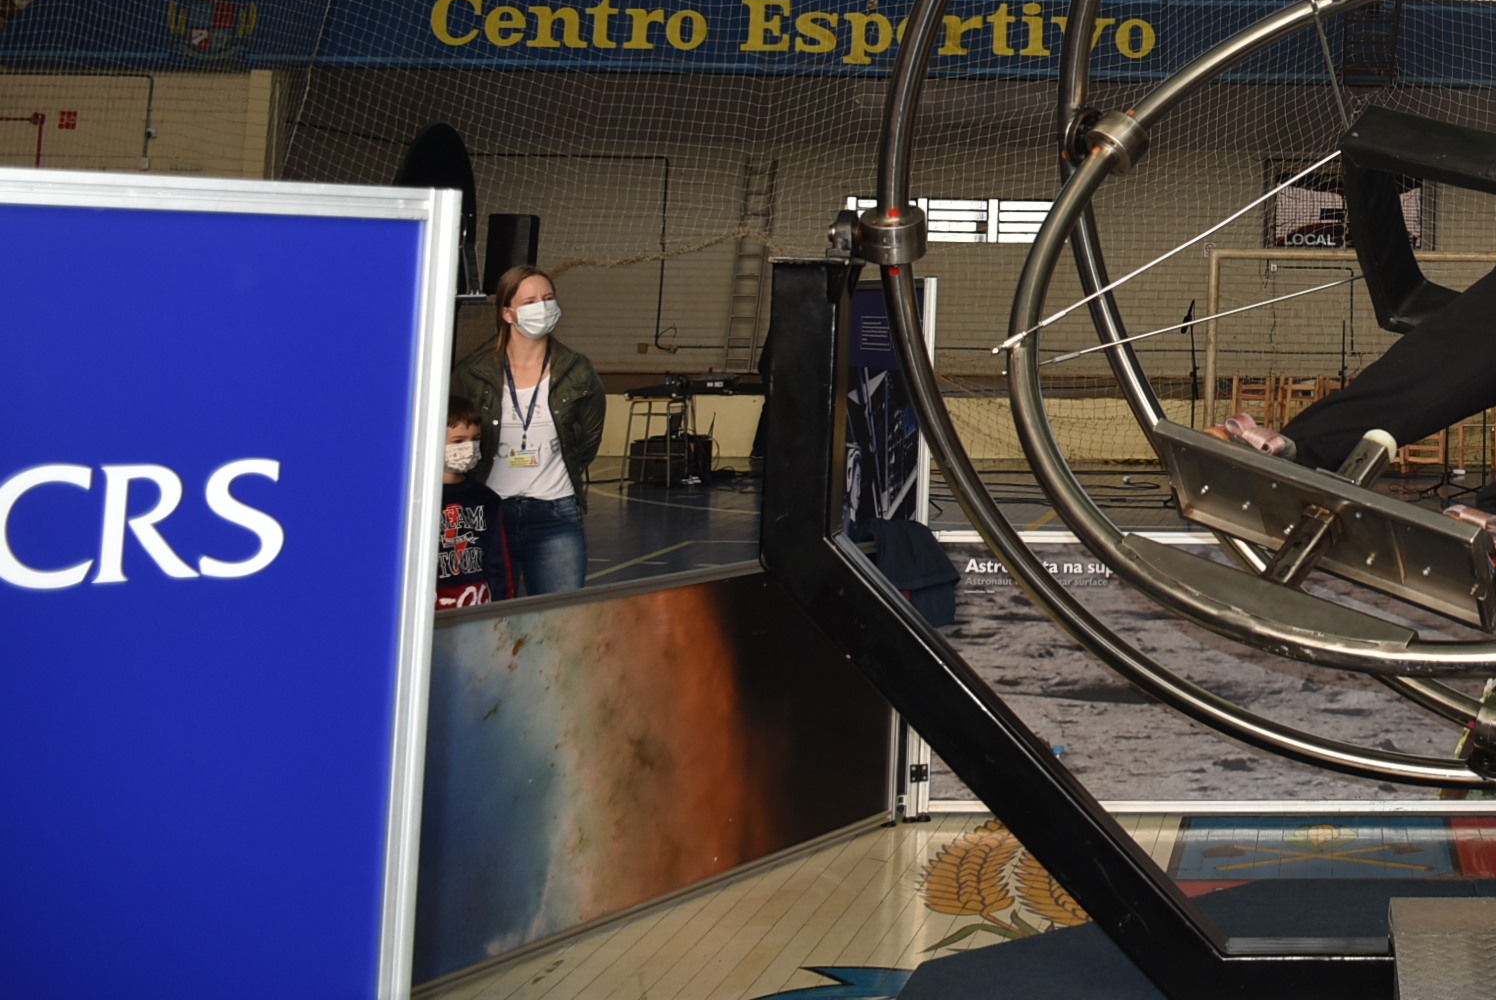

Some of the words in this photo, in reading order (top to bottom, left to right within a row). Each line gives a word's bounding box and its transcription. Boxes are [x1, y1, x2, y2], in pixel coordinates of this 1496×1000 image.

[1284, 233, 1336, 246] LOCAL
[0, 457, 285, 590] CRS
[1063, 563, 1083, 574] na
